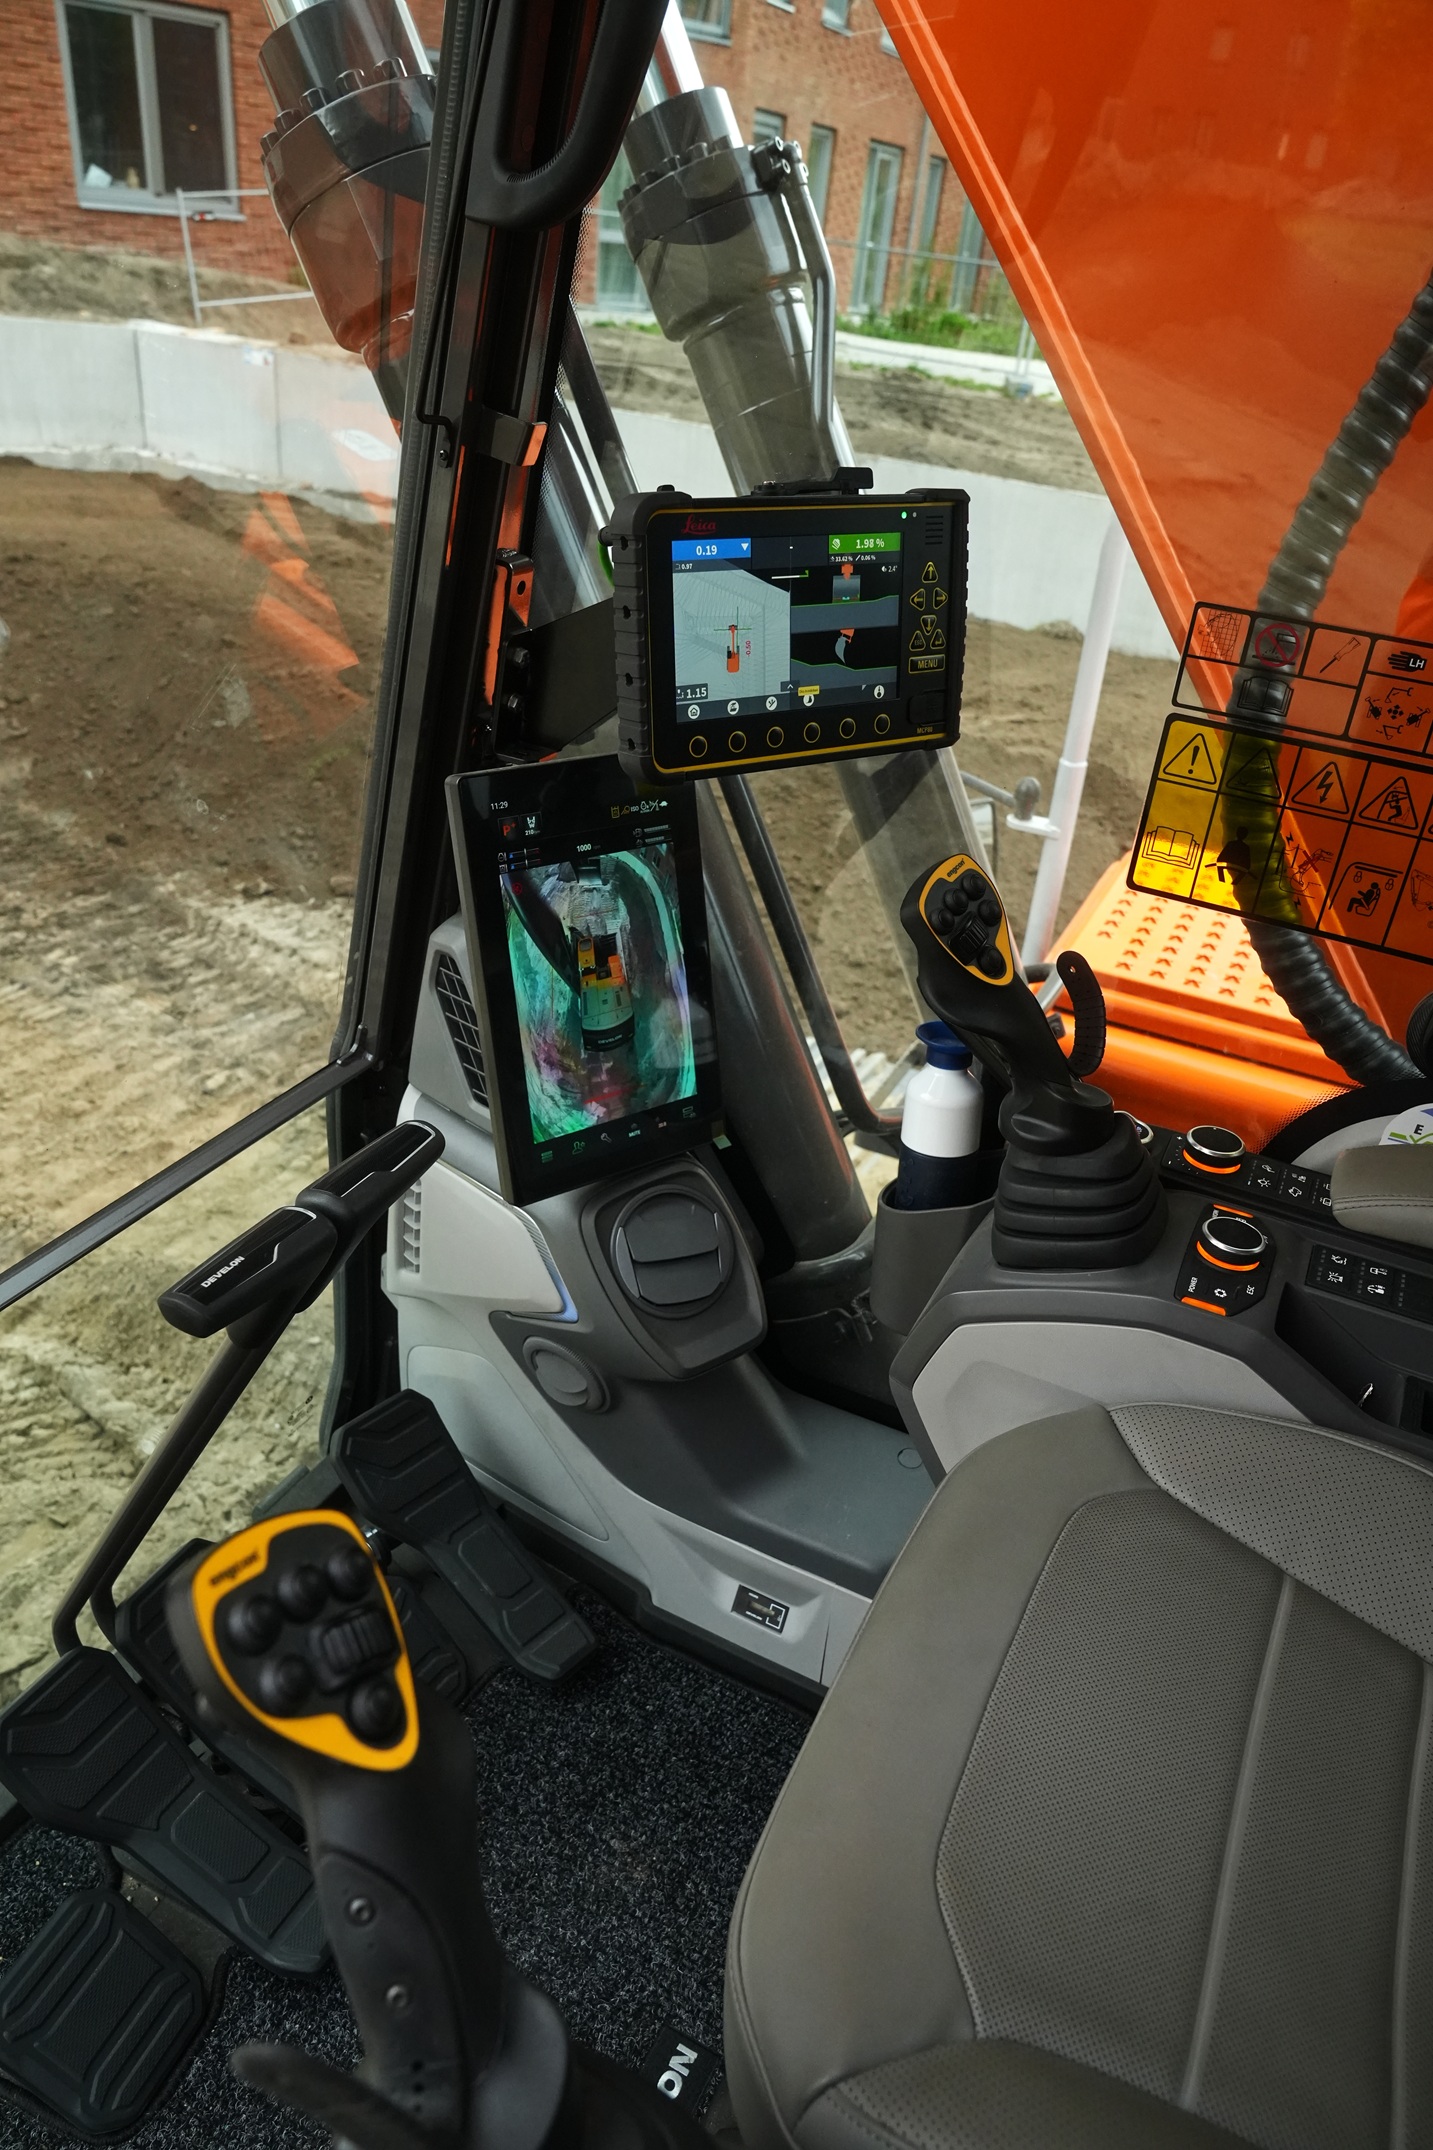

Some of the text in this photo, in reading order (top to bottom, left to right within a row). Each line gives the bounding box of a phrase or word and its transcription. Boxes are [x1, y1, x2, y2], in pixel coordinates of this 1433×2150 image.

[681, 514, 717, 535] Leica
[856, 538, 885, 549] 1.98 %
[695, 545, 718, 556] 0.19
[917, 658, 938, 669] MENU
[1408, 658, 1425, 669] LH
[686, 687, 707, 699] 1.15
[490, 801, 509, 810] 11:29
[576, 843, 592, 852] 1000
[947, 858, 966, 878] engcon
[1413, 1123, 1425, 1136] E
[201, 1255, 245, 1288] DEVELON
[1188, 1276, 1198, 1293] POWER
[1246, 1284, 1255, 1295] ESC
